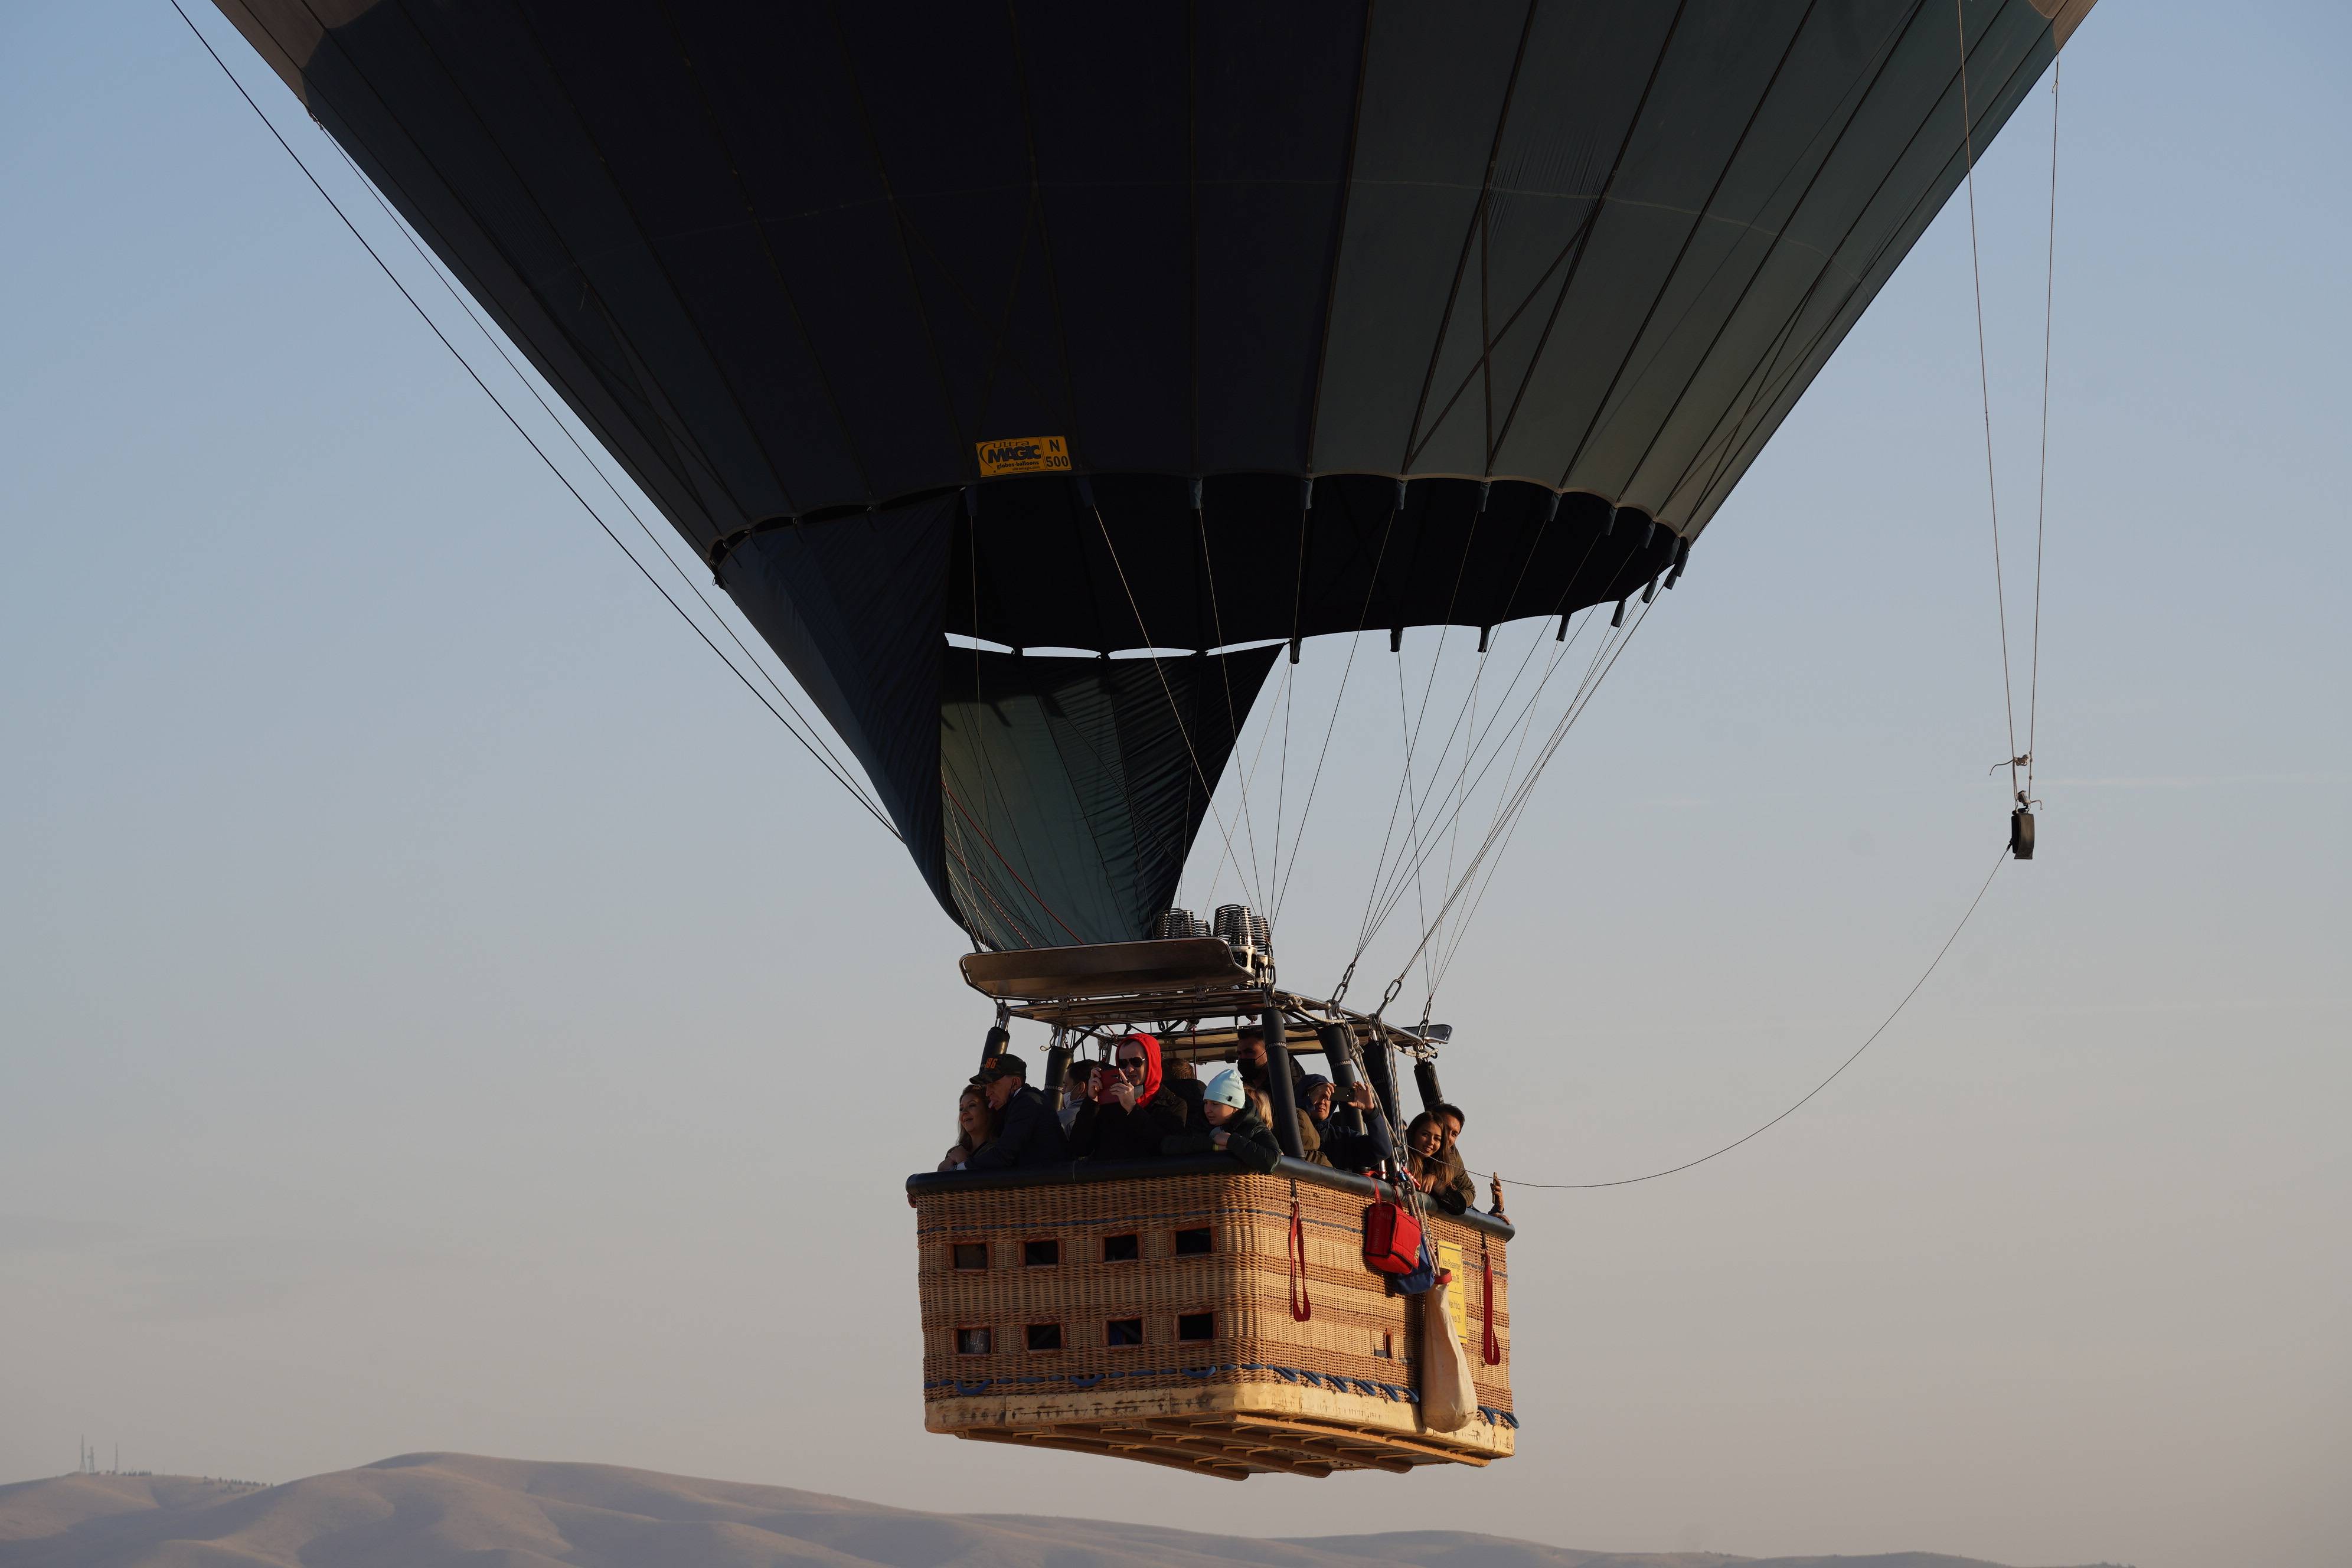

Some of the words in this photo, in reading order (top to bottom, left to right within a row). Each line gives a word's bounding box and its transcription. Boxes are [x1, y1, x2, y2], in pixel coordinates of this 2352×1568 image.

[1048, 439, 1060, 452] N
[988, 445, 1041, 464] MAGIC
[997, 460, 1040, 470] globos-balloons
[1046, 455, 1069, 467] 500
